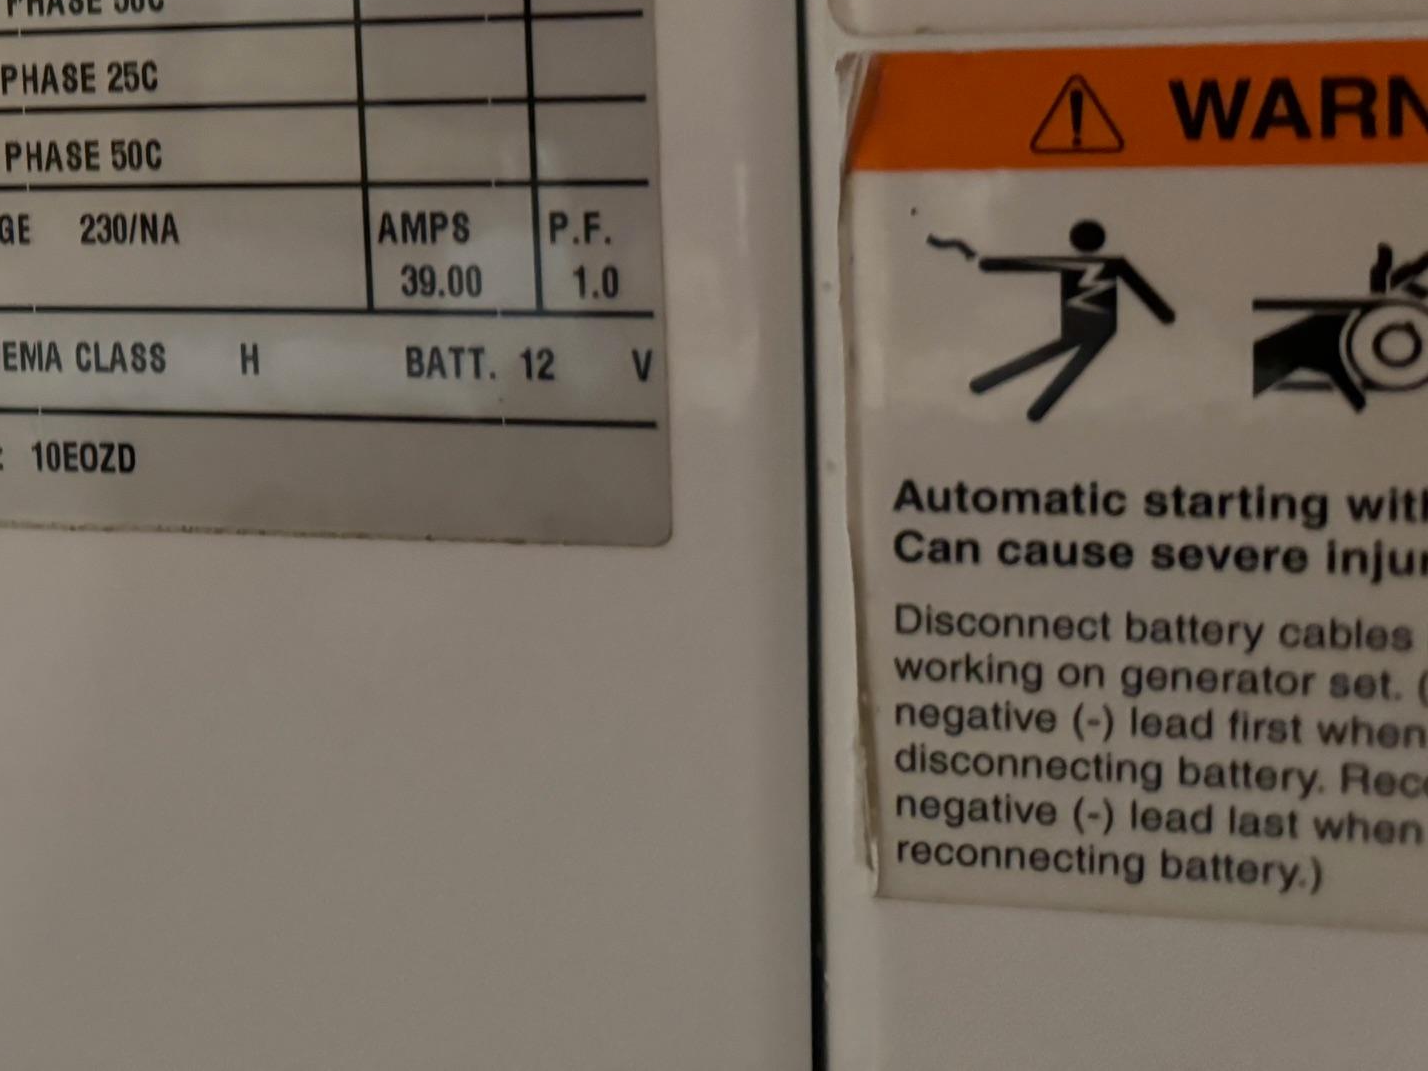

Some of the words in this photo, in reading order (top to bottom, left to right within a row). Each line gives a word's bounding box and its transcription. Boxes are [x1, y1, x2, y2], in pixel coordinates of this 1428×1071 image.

[0, 62, 96, 95] PHASE
[107, 61, 159, 93] 25C
[5, 141, 101, 173] PHASE
[110, 140, 163, 172] 50C
[79, 212, 180, 246] 230/NA
[377, 211, 471, 244] AMPS
[550, 212, 613, 246] P.F.
[400, 264, 483, 299] 39.00
[572, 267, 620, 299] 1.0
[75, 342, 167, 374] CLASS
[240, 344, 261, 376] H
[405, 347, 496, 380] BATT.
[520, 348, 555, 381] 12
[631, 350, 652, 382] V
[31, 440, 137, 474] 10EOZD
[893, 478, 1126, 518] Automatic
[1143, 484, 1329, 530] starting
[894, 529, 980, 566] Can
[998, 537, 1133, 570] cause
[1151, 542, 1309, 575] severe
[894, 603, 1110, 643] Disconnect
[1126, 611, 1264, 654] battery
[1279, 616, 1413, 652] cables
[894, 651, 1043, 693] working
[1058, 661, 1105, 689] on
[1121, 663, 1316, 697] generator
[895, 744, 1162, 790] disconnecting
[1178, 755, 1324, 800] battery.
[896, 792, 1057, 829] negative
[1130, 801, 1213, 836] lead
[1229, 805, 1298, 839] last
[1313, 811, 1422, 845] when
[897, 838, 1145, 885] reconnecting
[1160, 848, 1323, 893] battery.)
